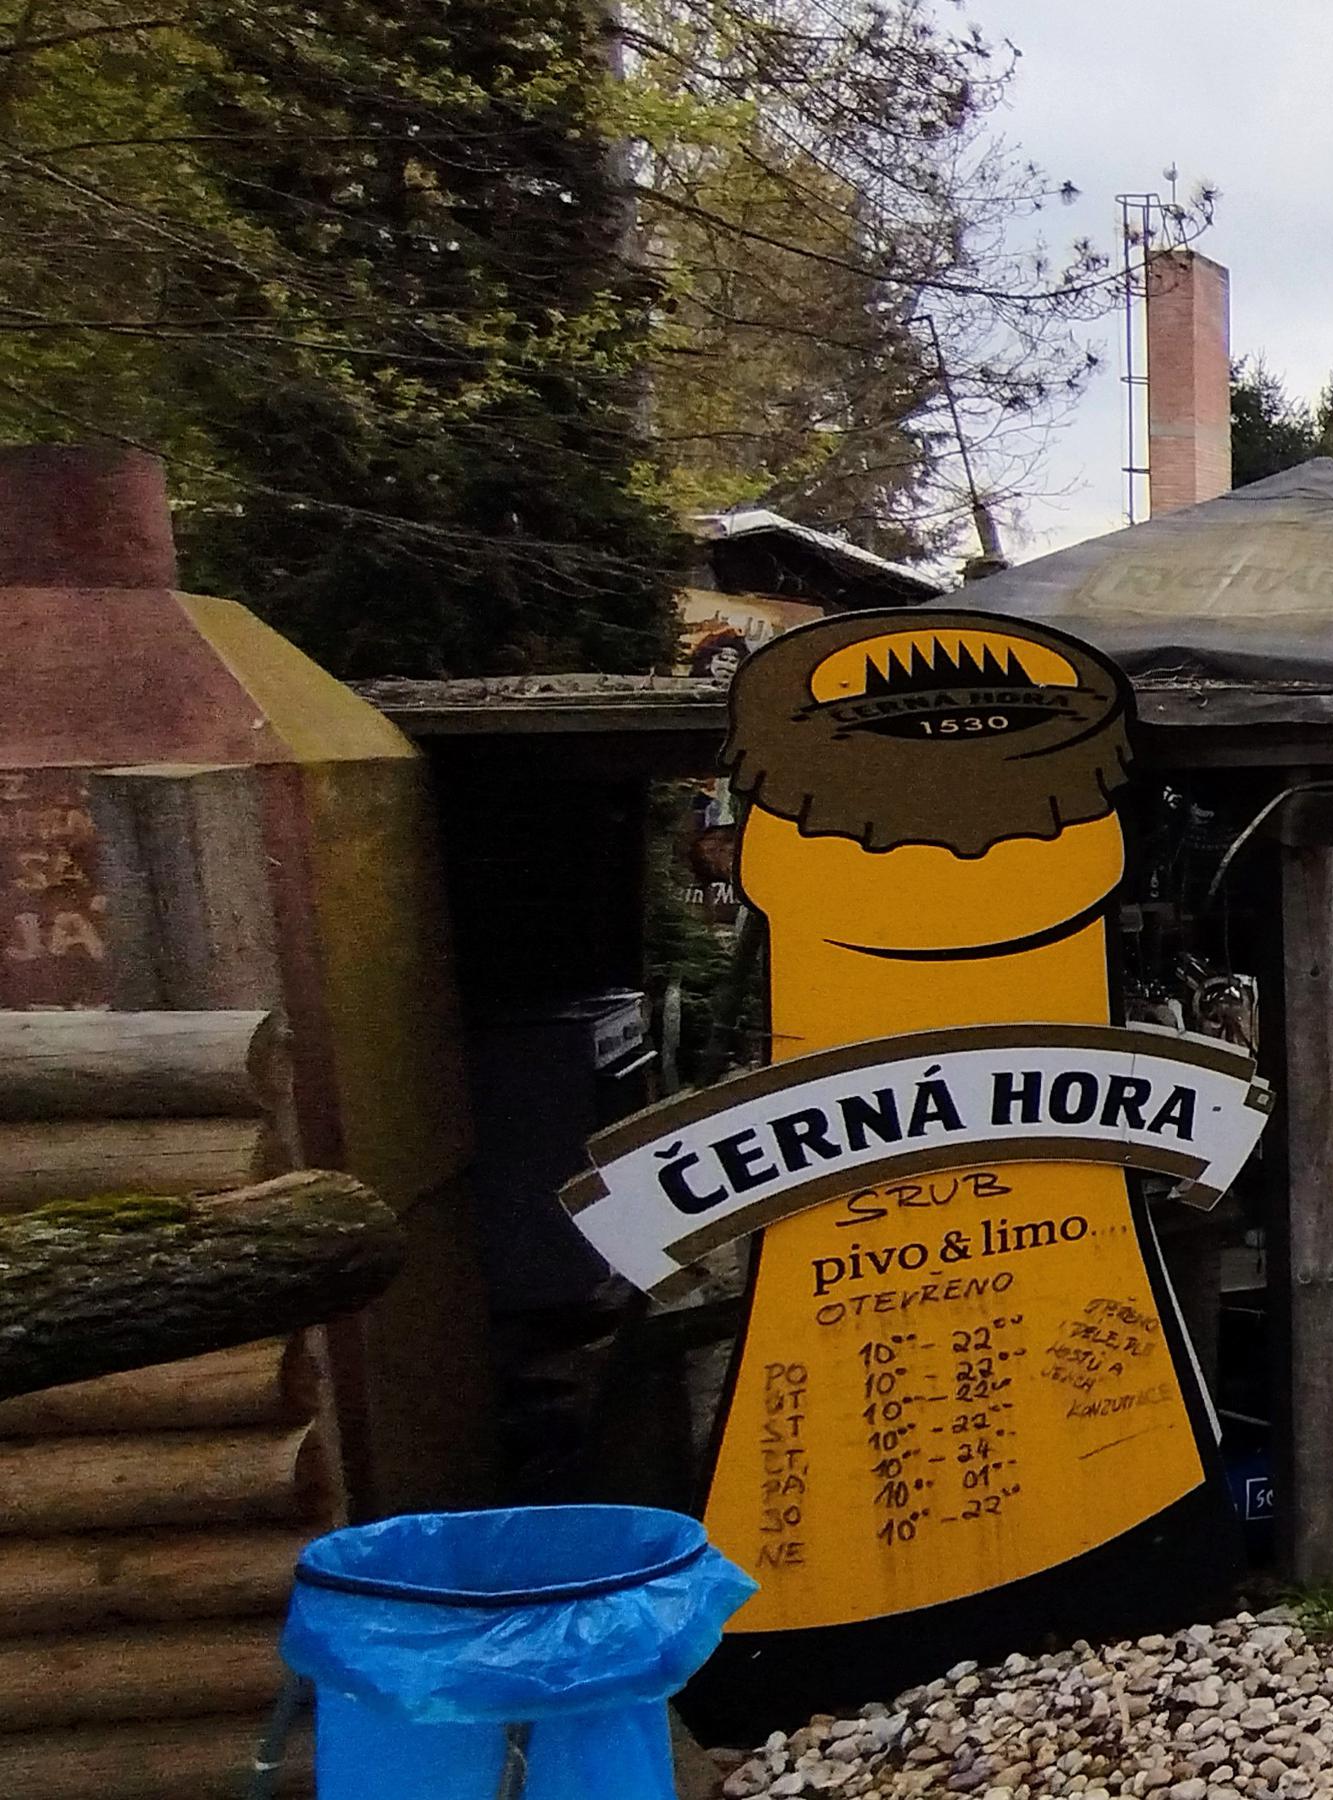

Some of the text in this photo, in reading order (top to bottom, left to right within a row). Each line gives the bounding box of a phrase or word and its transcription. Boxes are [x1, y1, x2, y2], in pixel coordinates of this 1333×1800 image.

[920, 714, 1009, 735] 1530
[655, 1064, 1197, 1215] ČERNÁ HORA
[836, 1172, 1013, 1227] SRUB
[812, 1242, 929, 1297] pivo
[940, 1230, 971, 1263] &
[816, 1271, 1014, 1326] OTEVŘENO
[764, 1362, 808, 1391] PO
